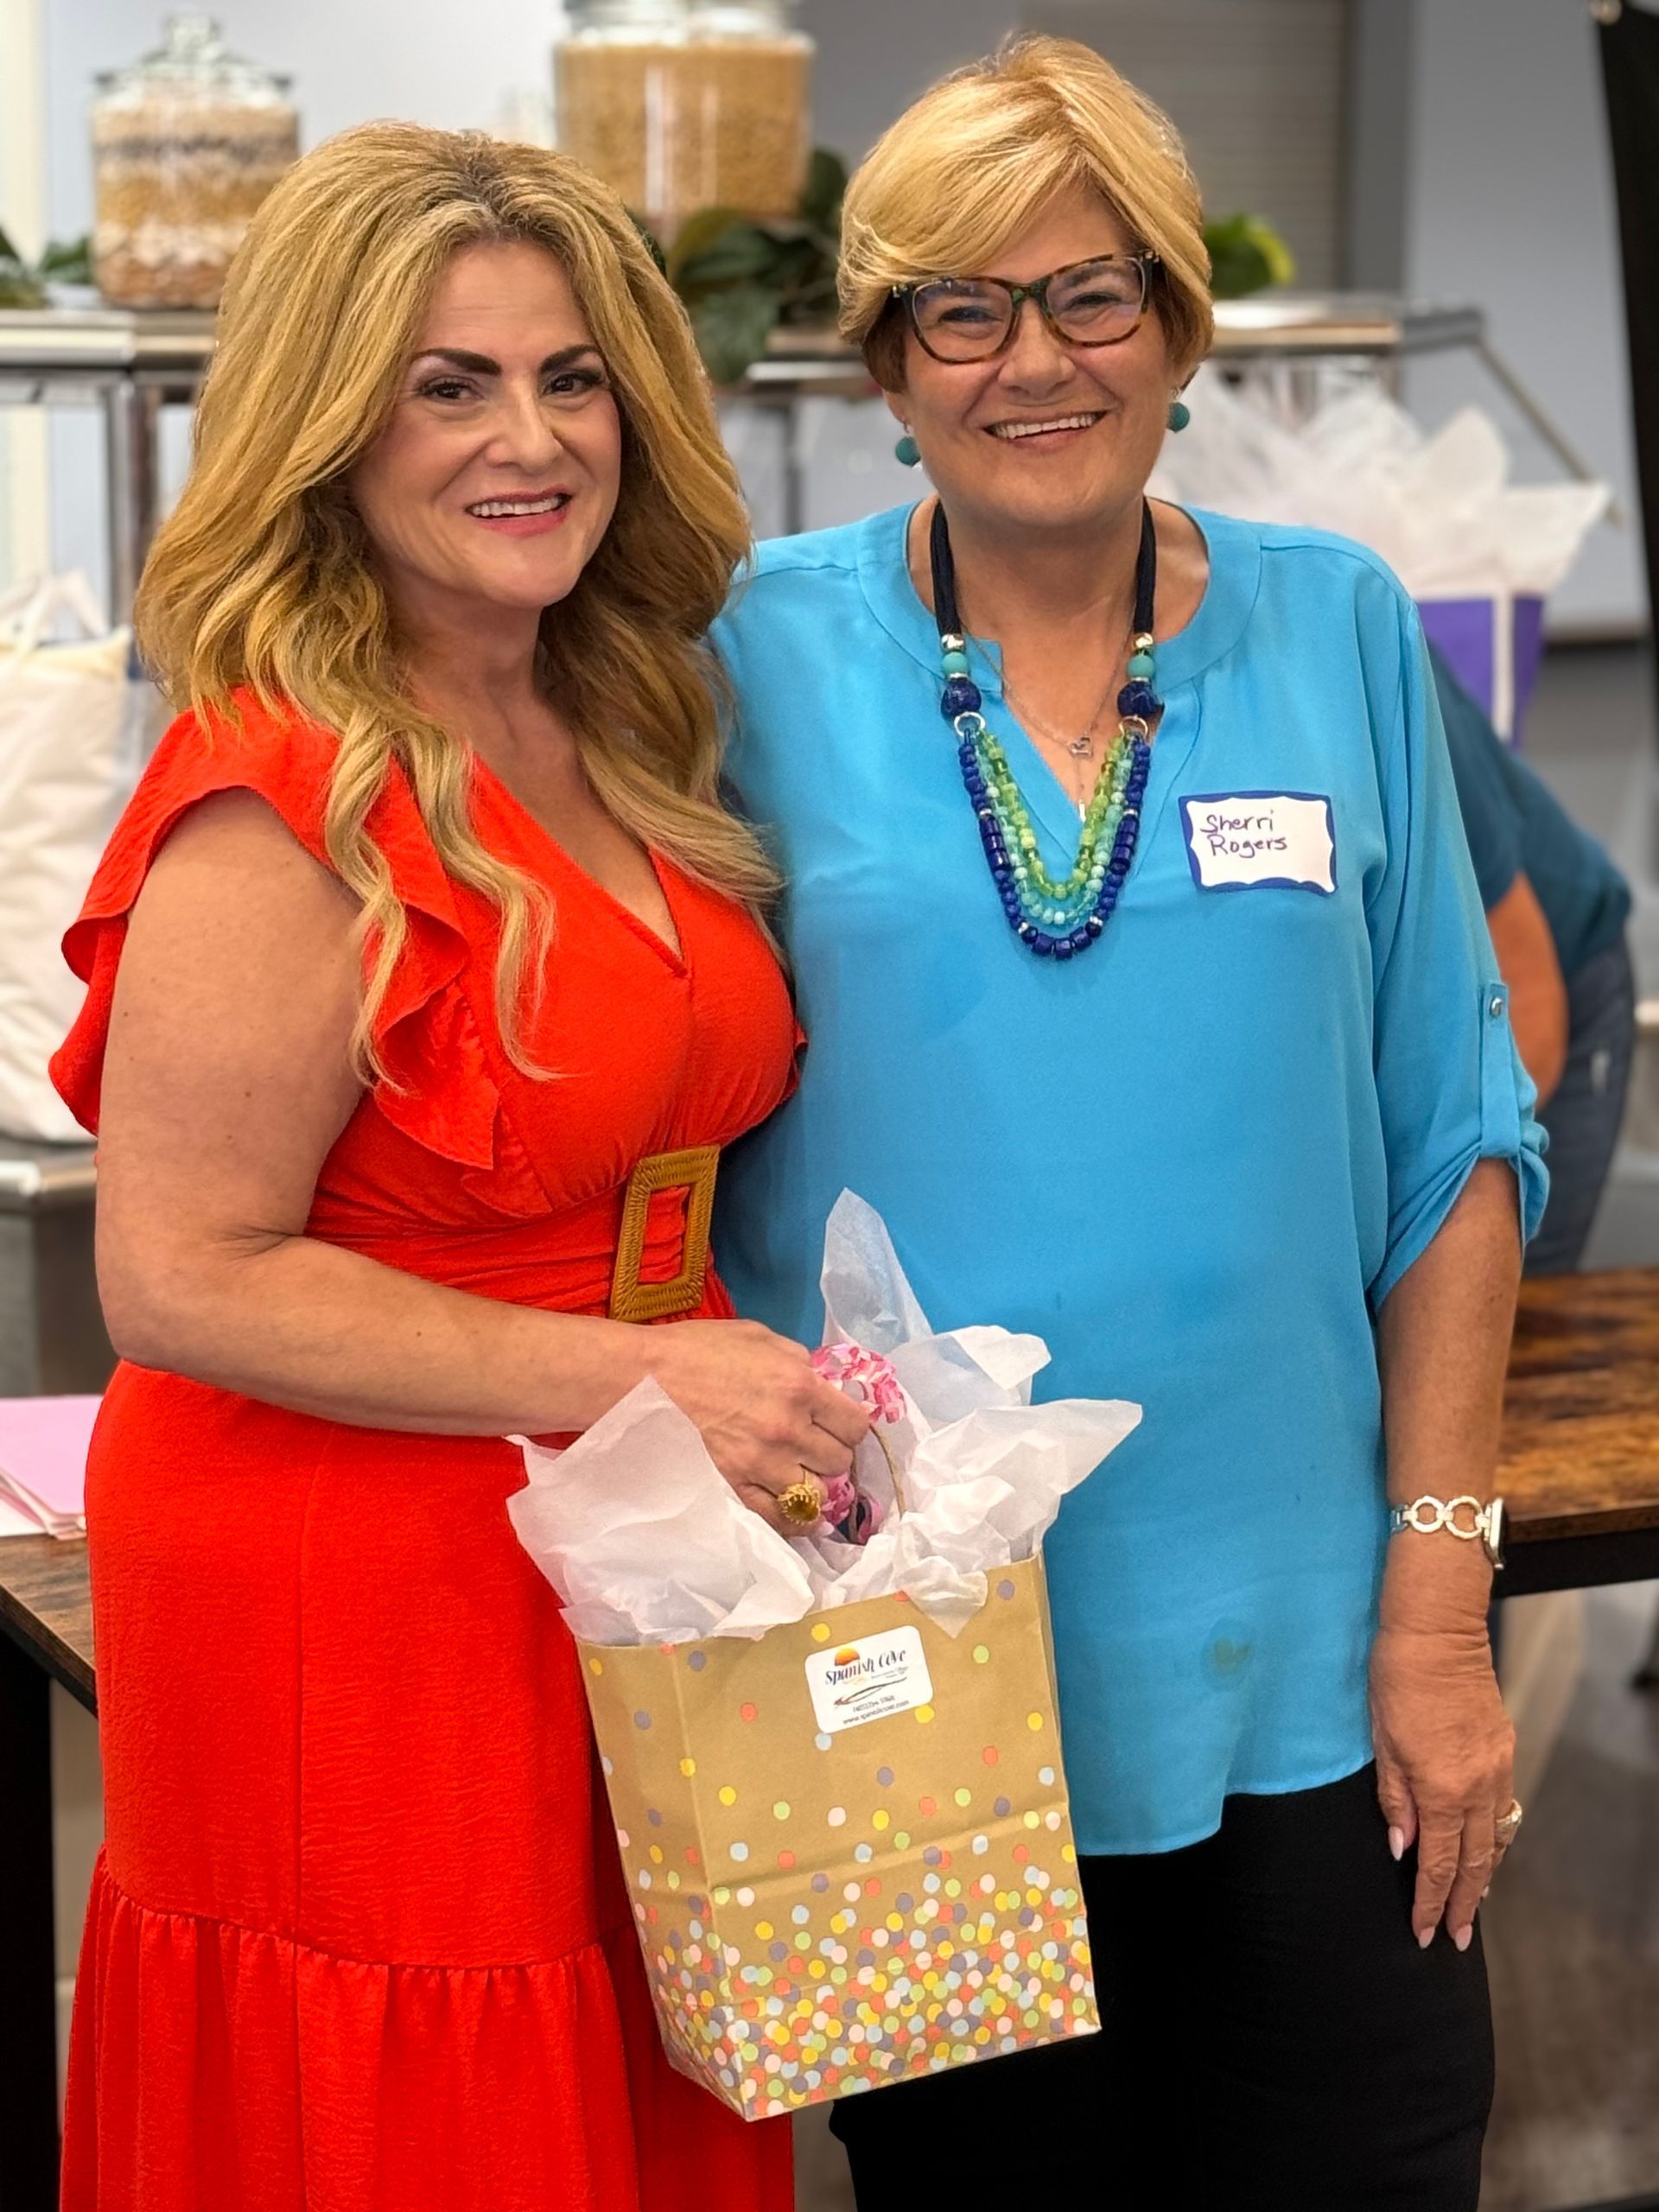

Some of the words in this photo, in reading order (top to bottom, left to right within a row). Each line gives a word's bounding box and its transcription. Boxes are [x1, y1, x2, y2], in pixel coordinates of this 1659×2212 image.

[1199, 810, 1274, 833] Sherri
[1206, 833, 1287, 859] Rogers
[825, 1658, 874, 1686] Spanish
